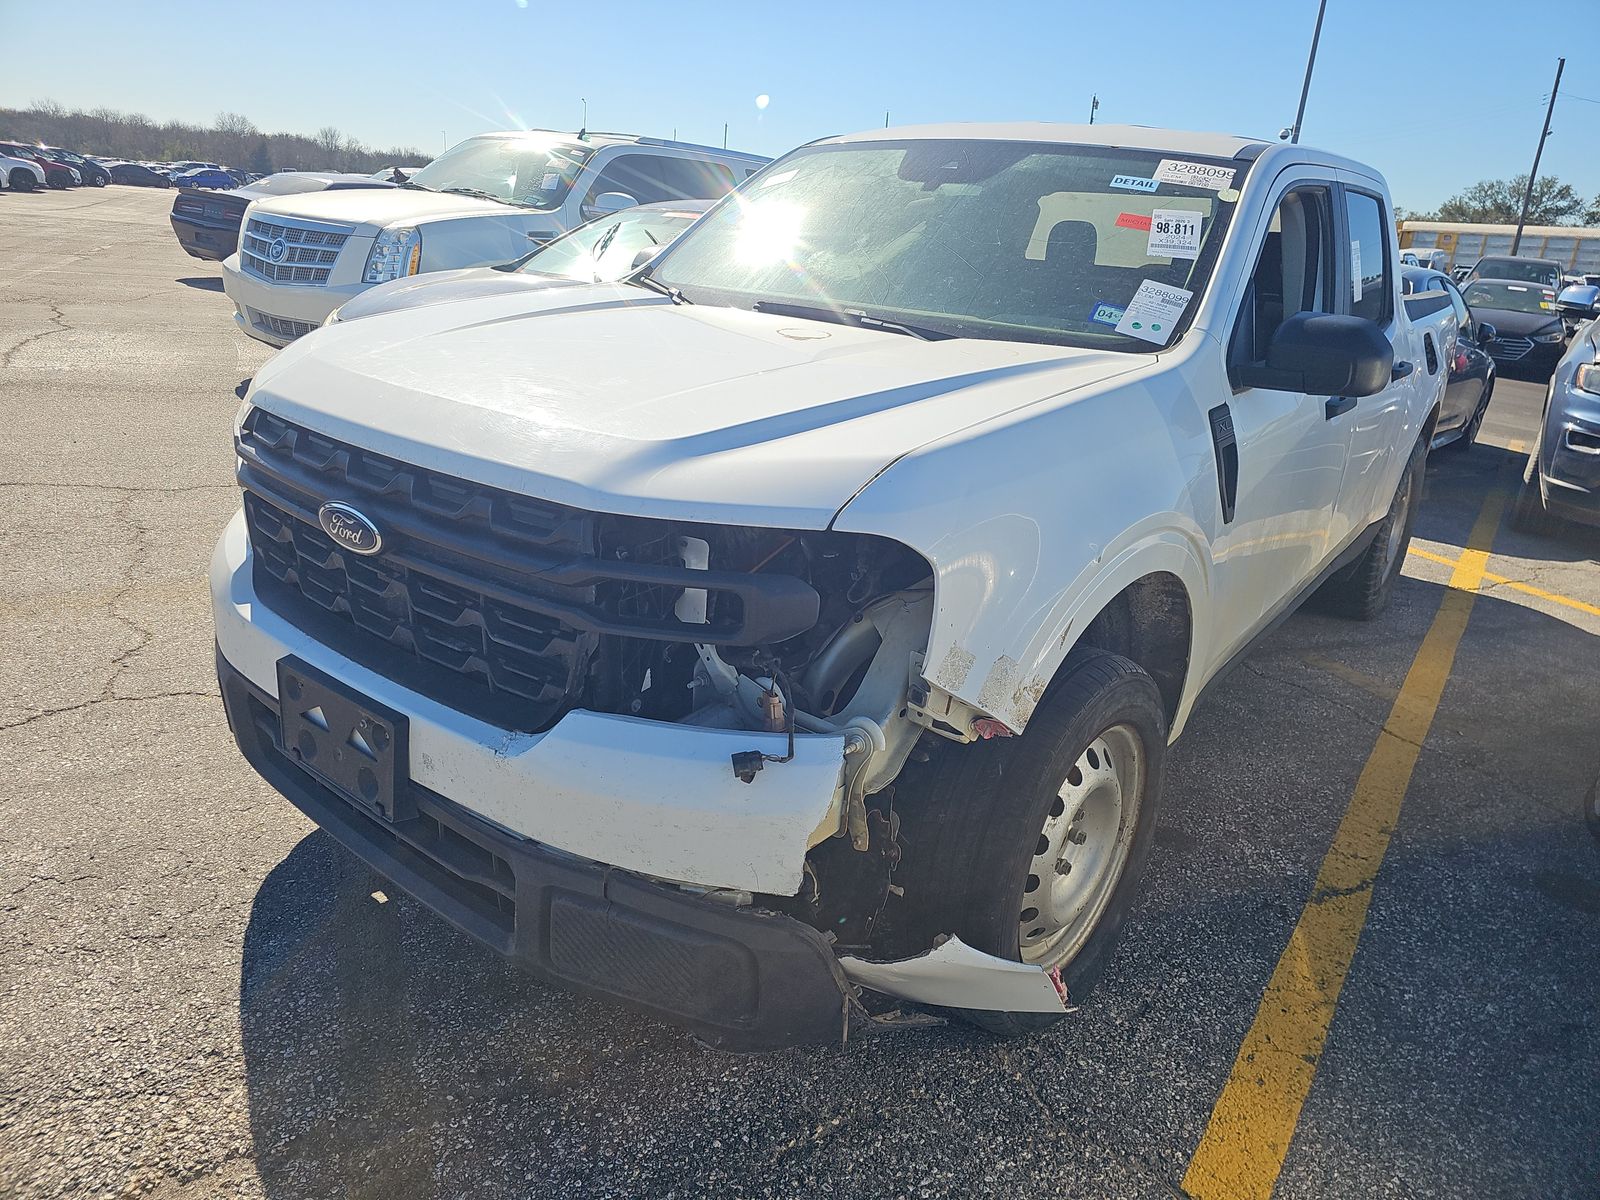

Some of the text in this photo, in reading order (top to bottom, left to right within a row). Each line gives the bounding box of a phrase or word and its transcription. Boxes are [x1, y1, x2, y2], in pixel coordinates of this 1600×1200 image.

[1114, 177, 1155, 188] DETAIL
[1156, 221, 1195, 236] 98:811
[1141, 285, 1190, 304] 3288099
[1218, 420, 1232, 433] XL
[330, 513, 363, 544] Ford
